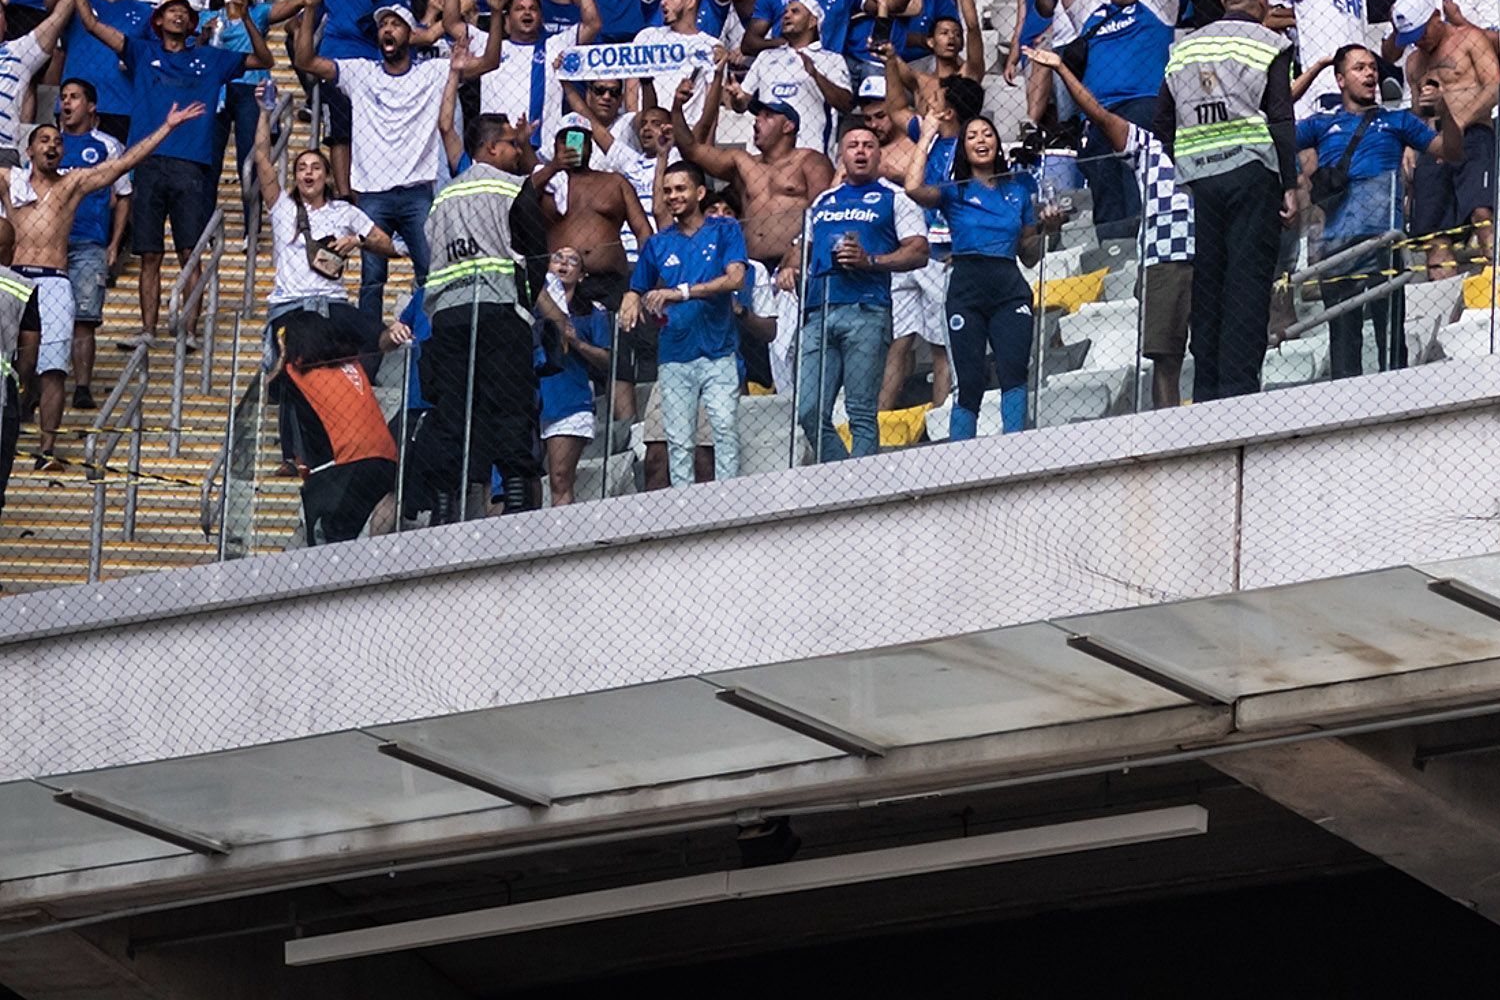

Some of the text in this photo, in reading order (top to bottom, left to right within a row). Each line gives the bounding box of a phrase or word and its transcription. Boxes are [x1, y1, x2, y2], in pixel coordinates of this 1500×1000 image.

[587, 43, 686, 68] CORINTO
[1194, 101, 1228, 124] 1770
[823, 207, 880, 223] betfair
